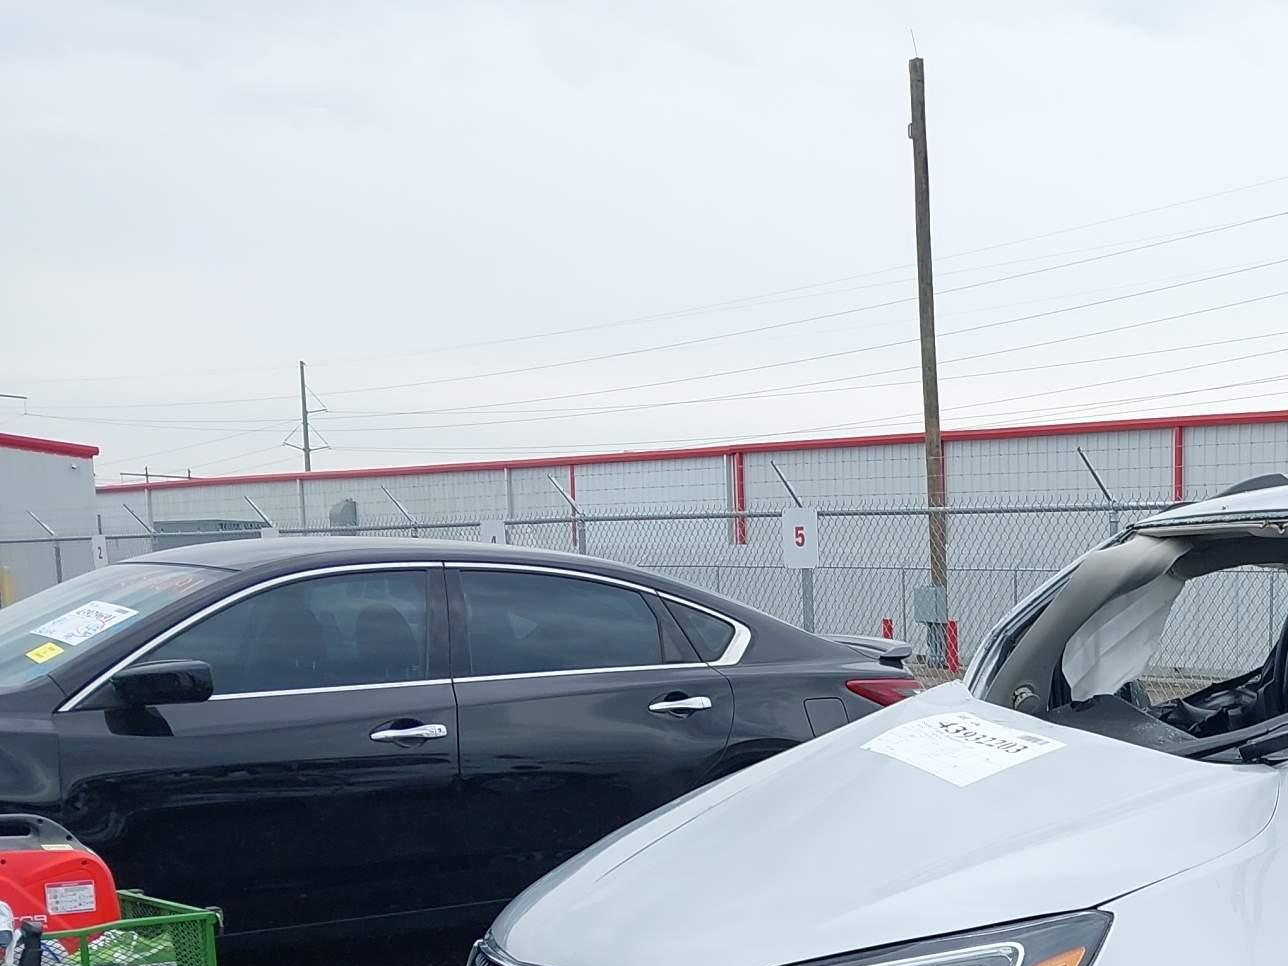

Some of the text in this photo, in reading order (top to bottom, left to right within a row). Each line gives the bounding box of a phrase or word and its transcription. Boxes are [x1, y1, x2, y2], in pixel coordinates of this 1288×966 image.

[794, 526, 805, 547] 5
[97, 546, 103, 559] 2
[938, 720, 1029, 754] 43932203
